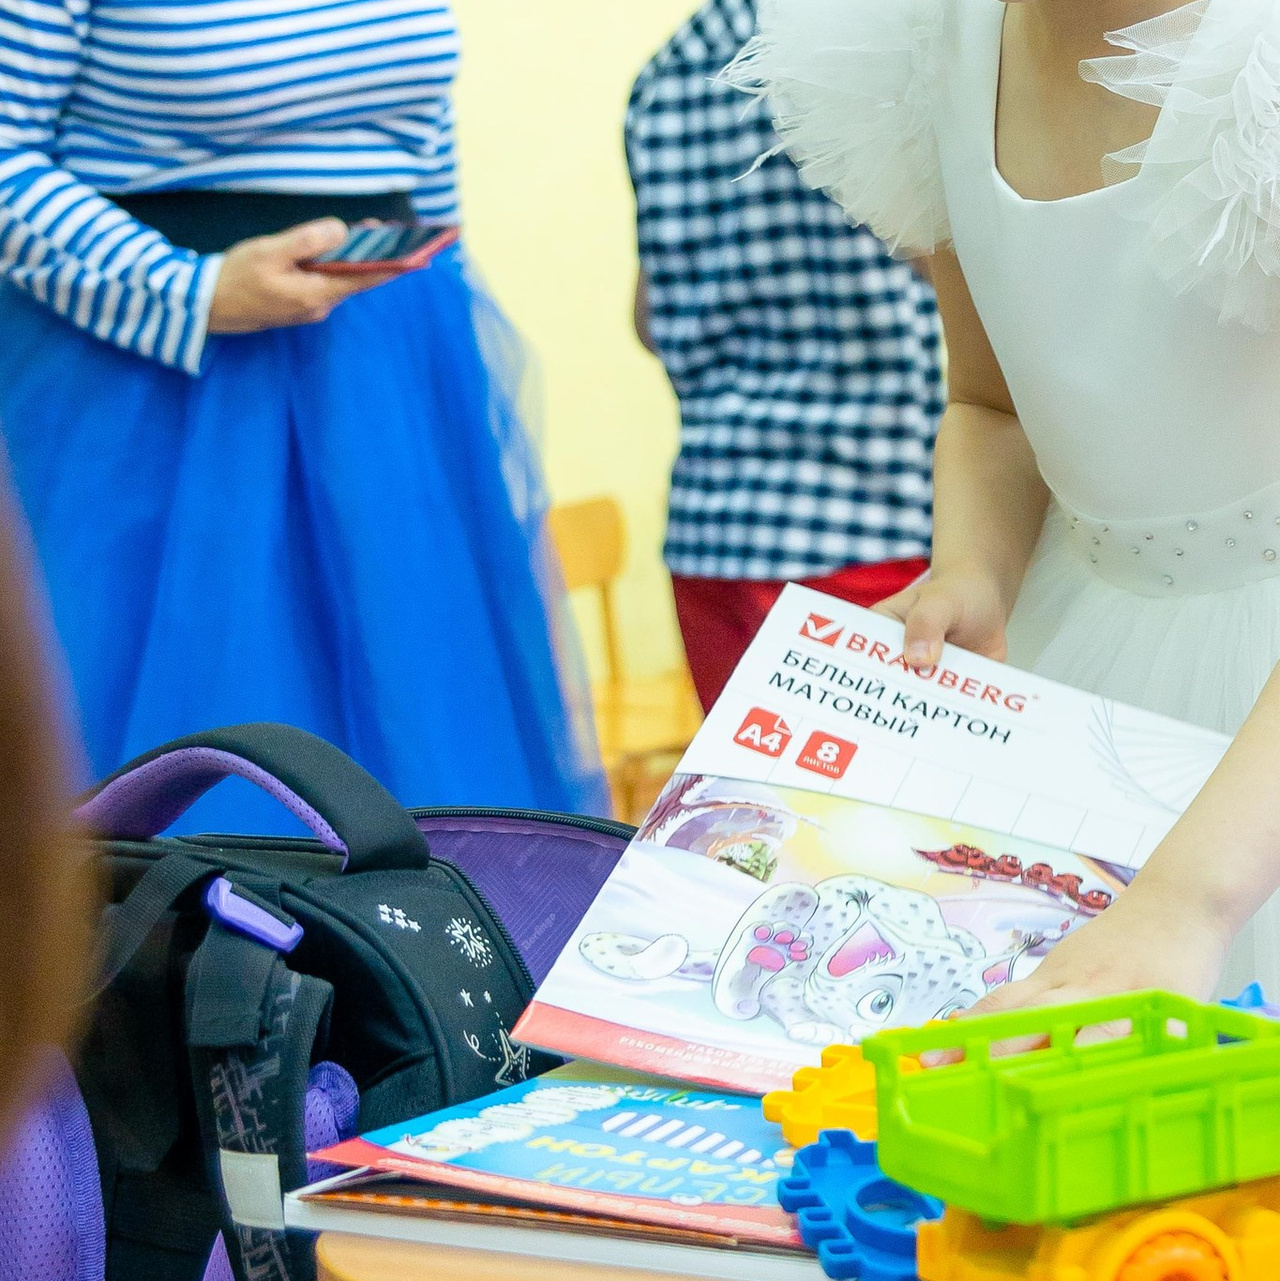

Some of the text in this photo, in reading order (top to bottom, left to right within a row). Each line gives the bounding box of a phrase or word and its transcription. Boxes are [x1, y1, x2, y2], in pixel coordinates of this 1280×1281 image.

[782, 649, 1012, 745] БЕЛЫЙ КАРТОН
[846, 632, 1029, 713] BRAUBERG
[768, 671, 919, 738] МАТОВЫЙ
[738, 723, 782, 752] A4
[816, 741, 840, 763] 8
[526, 1136, 779, 1183] КАРТОН
